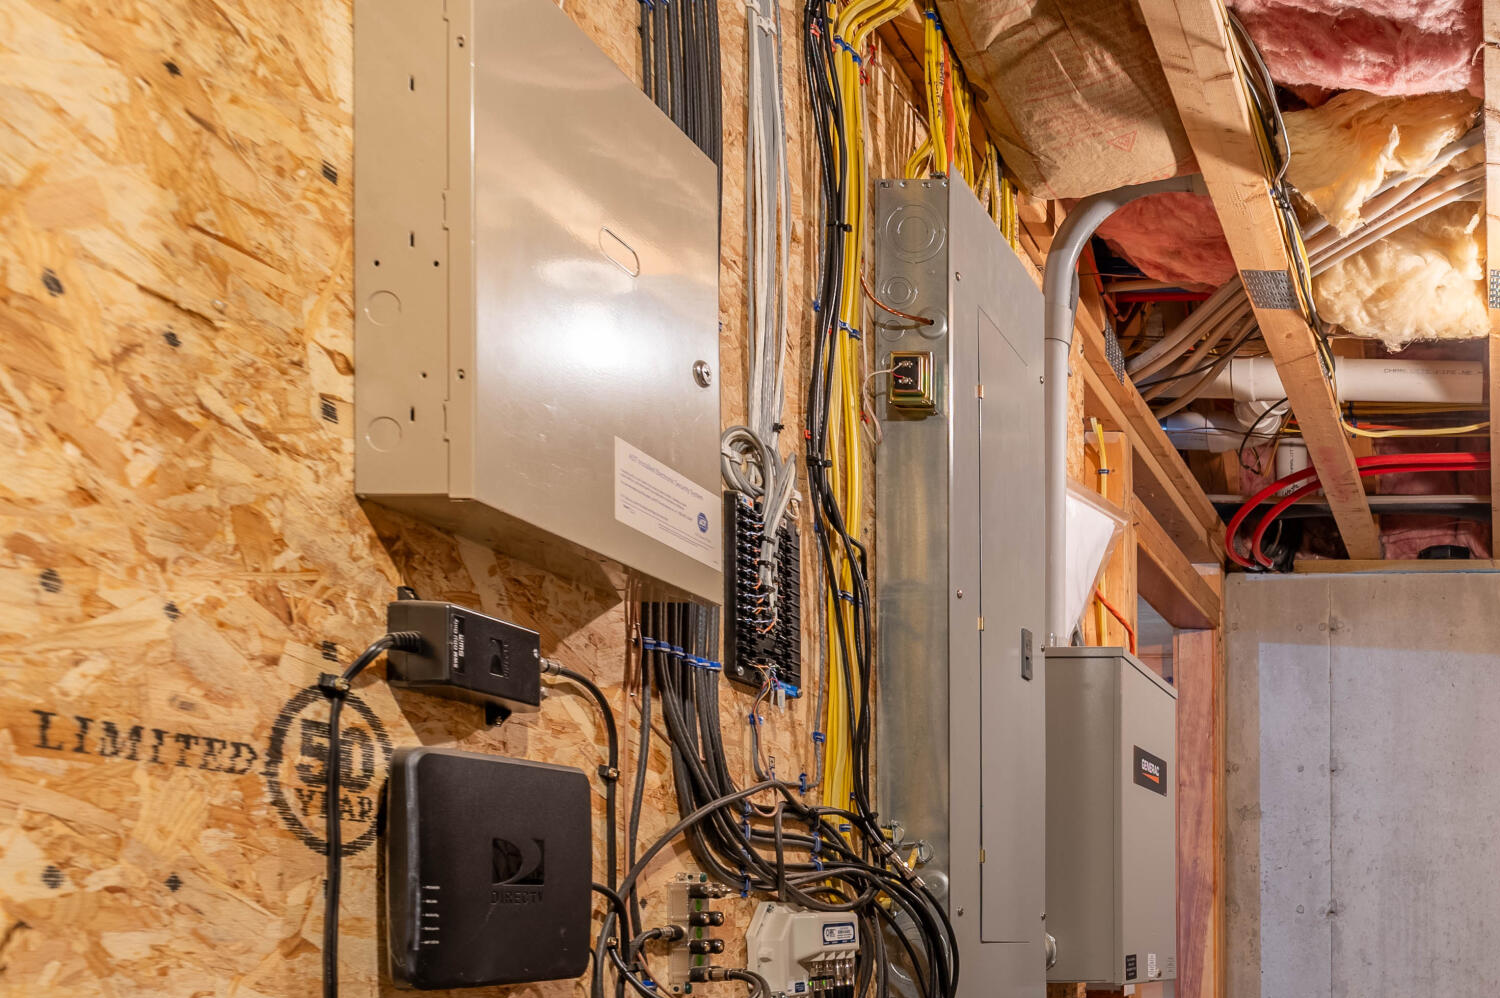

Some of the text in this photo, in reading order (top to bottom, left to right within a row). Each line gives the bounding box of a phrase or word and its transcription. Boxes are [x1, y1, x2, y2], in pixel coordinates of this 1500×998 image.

[32, 709, 257, 775] LIMITED
[295, 718, 376, 793] 50
[1141, 758, 1160, 777] GENERAC
[491, 890, 545, 905] DIRECTV
